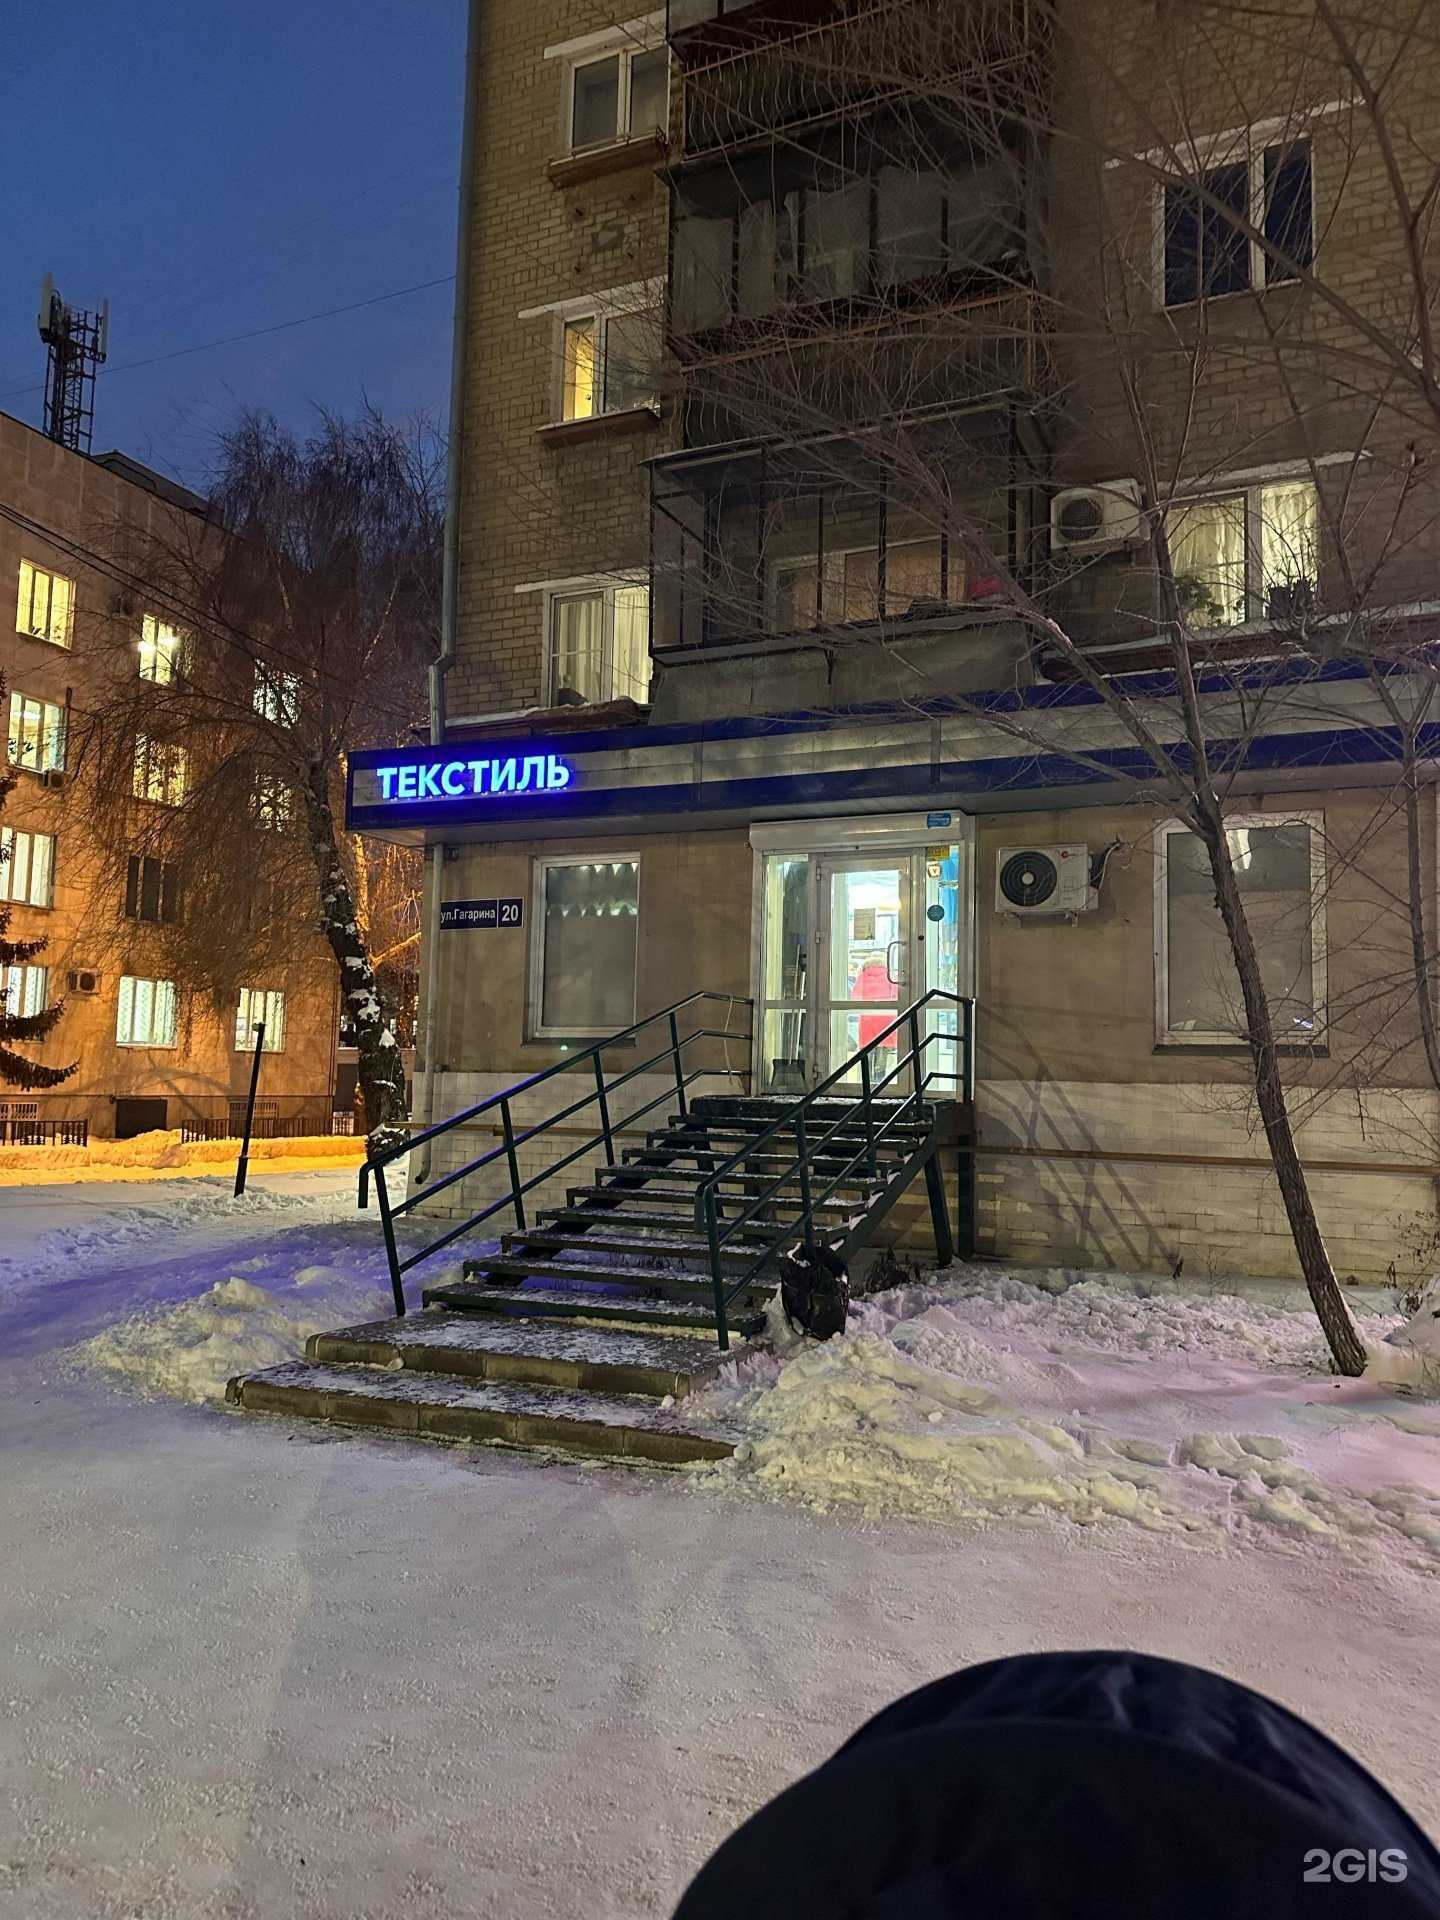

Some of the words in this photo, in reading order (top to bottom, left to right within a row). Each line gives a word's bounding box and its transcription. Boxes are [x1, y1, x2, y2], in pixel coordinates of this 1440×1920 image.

[377, 755, 570, 799] ТЕКСТИЛЬ
[440, 908, 496, 923] ул.Гагарина
[501, 904, 519, 922] 20
